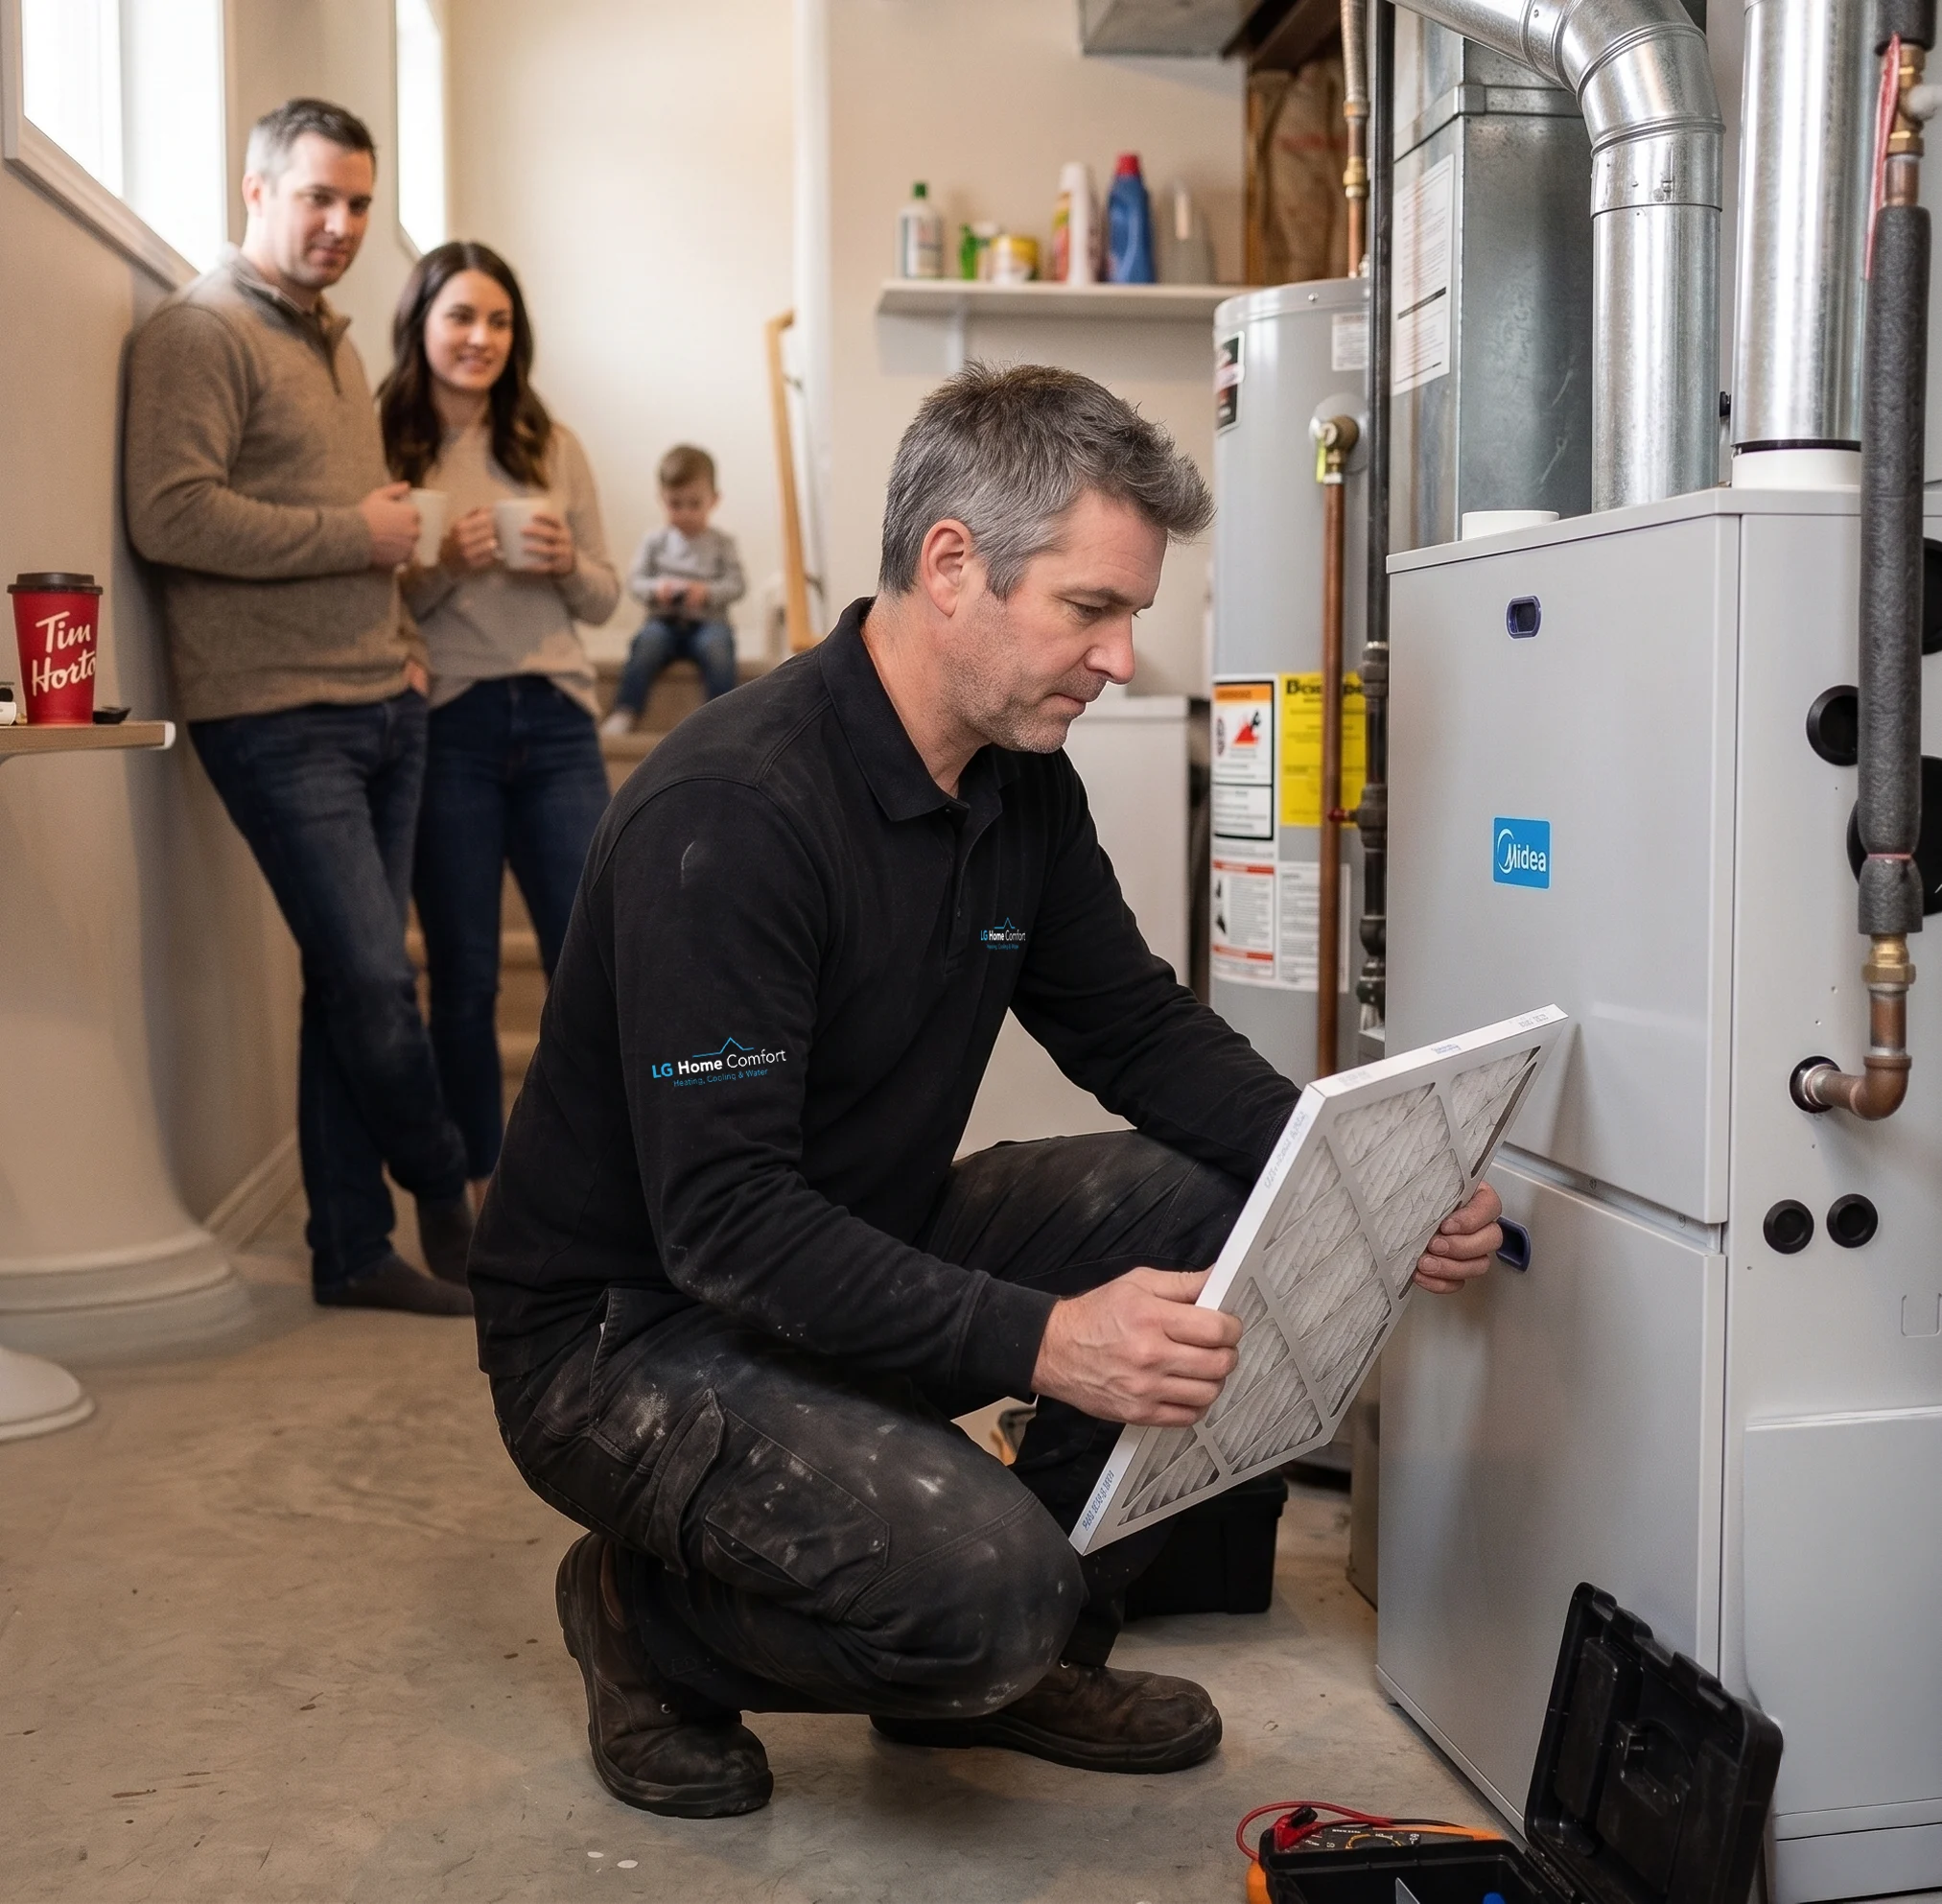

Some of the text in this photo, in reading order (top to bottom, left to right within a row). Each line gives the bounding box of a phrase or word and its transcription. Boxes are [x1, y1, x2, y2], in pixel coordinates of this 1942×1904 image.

[35, 611, 91, 653] Tim
[1497, 829, 1547, 874] Midea
[980, 929, 988, 941] LG
[989, 929, 1004, 941] Home
[652, 1048, 787, 1078] LG Home Comfort
[673, 1069, 768, 1088] Heating, Cooling & Water
